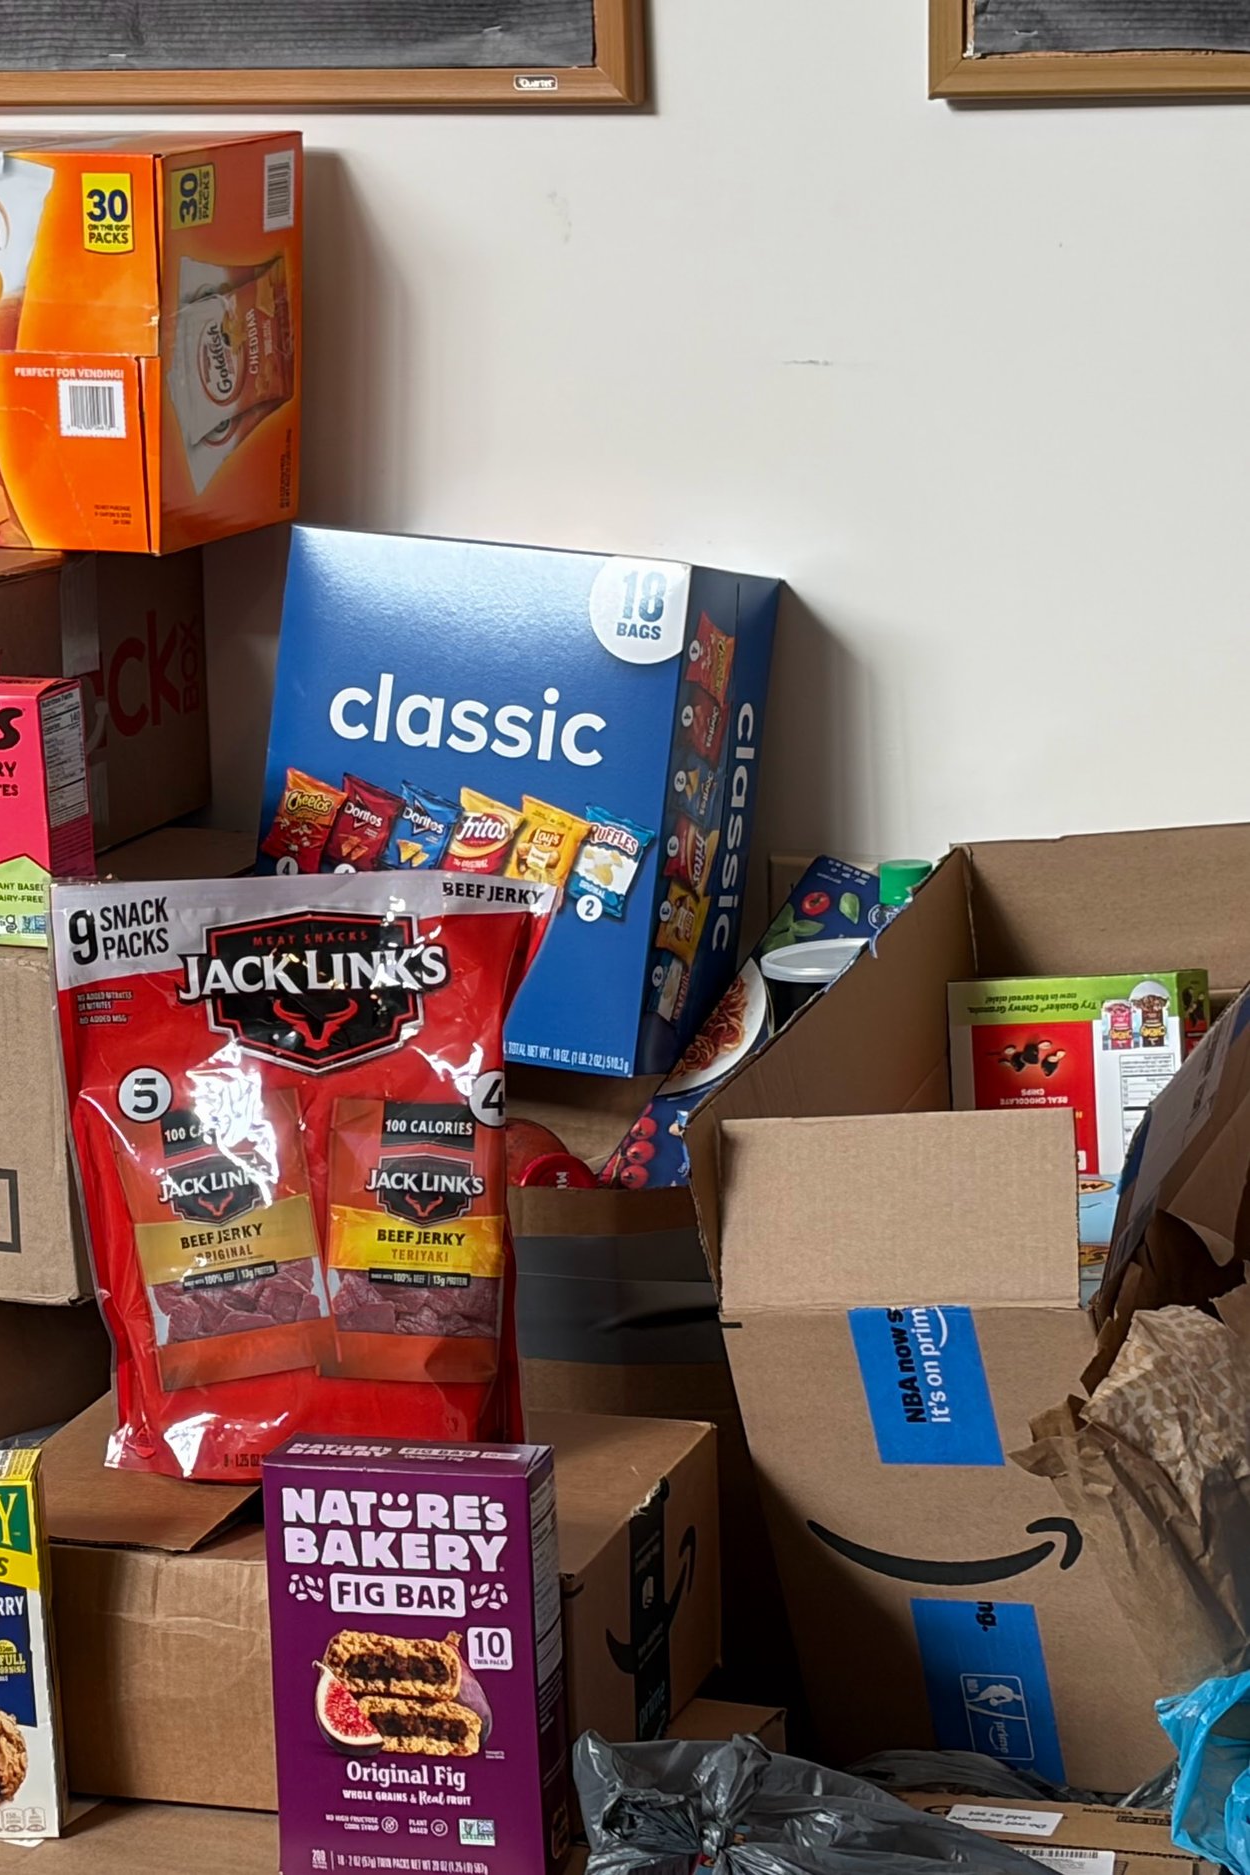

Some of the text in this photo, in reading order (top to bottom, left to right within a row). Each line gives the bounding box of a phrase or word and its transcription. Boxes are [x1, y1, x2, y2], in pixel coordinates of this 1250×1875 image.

[86, 189, 129, 222] 30
[179, 172, 198, 223] 30
[88, 233, 129, 244] PACKS
[208, 323, 233, 394] Goldfish
[14, 367, 125, 379] PERFECT FOR VENDING!
[623, 571, 666, 623] 18
[616, 622, 662, 641] BAGS
[329, 673, 607, 767] classic
[286, 791, 333, 816] Cheetos
[344, 801, 384, 828] Doritos
[402, 807, 446, 834] Doritos
[712, 703, 755, 951] classic
[589, 825, 638, 853] RUFFLES
[443, 882, 544, 905] BEEF JERKY
[100, 897, 169, 932] SNACK
[585, 901, 595, 916] 2
[69, 909, 99, 966] 9
[102, 927, 169, 960] PACKS
[253, 930, 369, 947] MEAT SNACKS
[178, 945, 446, 1000] JACK LINK'S
[1008, 1000, 1097, 1013] Try Chewy
[508, 1042, 538, 1057] TOTAL NET
[132, 1077, 159, 1115] 5
[481, 1079, 505, 1117] 4
[1000, 1097, 1048, 1105] CHOCOLATE
[164, 1128, 189, 1142] 100
[386, 1120, 473, 1136] 100 CALORIES
[366, 1171, 418, 1192] JACK
[181, 1223, 263, 1250] BEEF JERKY
[377, 1229, 466, 1246] BEEF JERKY
[391, 1248, 450, 1262] TERIYAKI
[890, 1327, 916, 1373] now
[897, 1375, 928, 1423] NBA
[922, 1361, 951, 1423] It's on
[284, 1527, 508, 1572] BAKERY
[337, 1583, 457, 1610] FIG BAR
[474, 1631, 505, 1658] 10
[347, 1761, 466, 1791] Original Fig
[342, 1789, 446, 1806] WHOLE GRAINS Real
